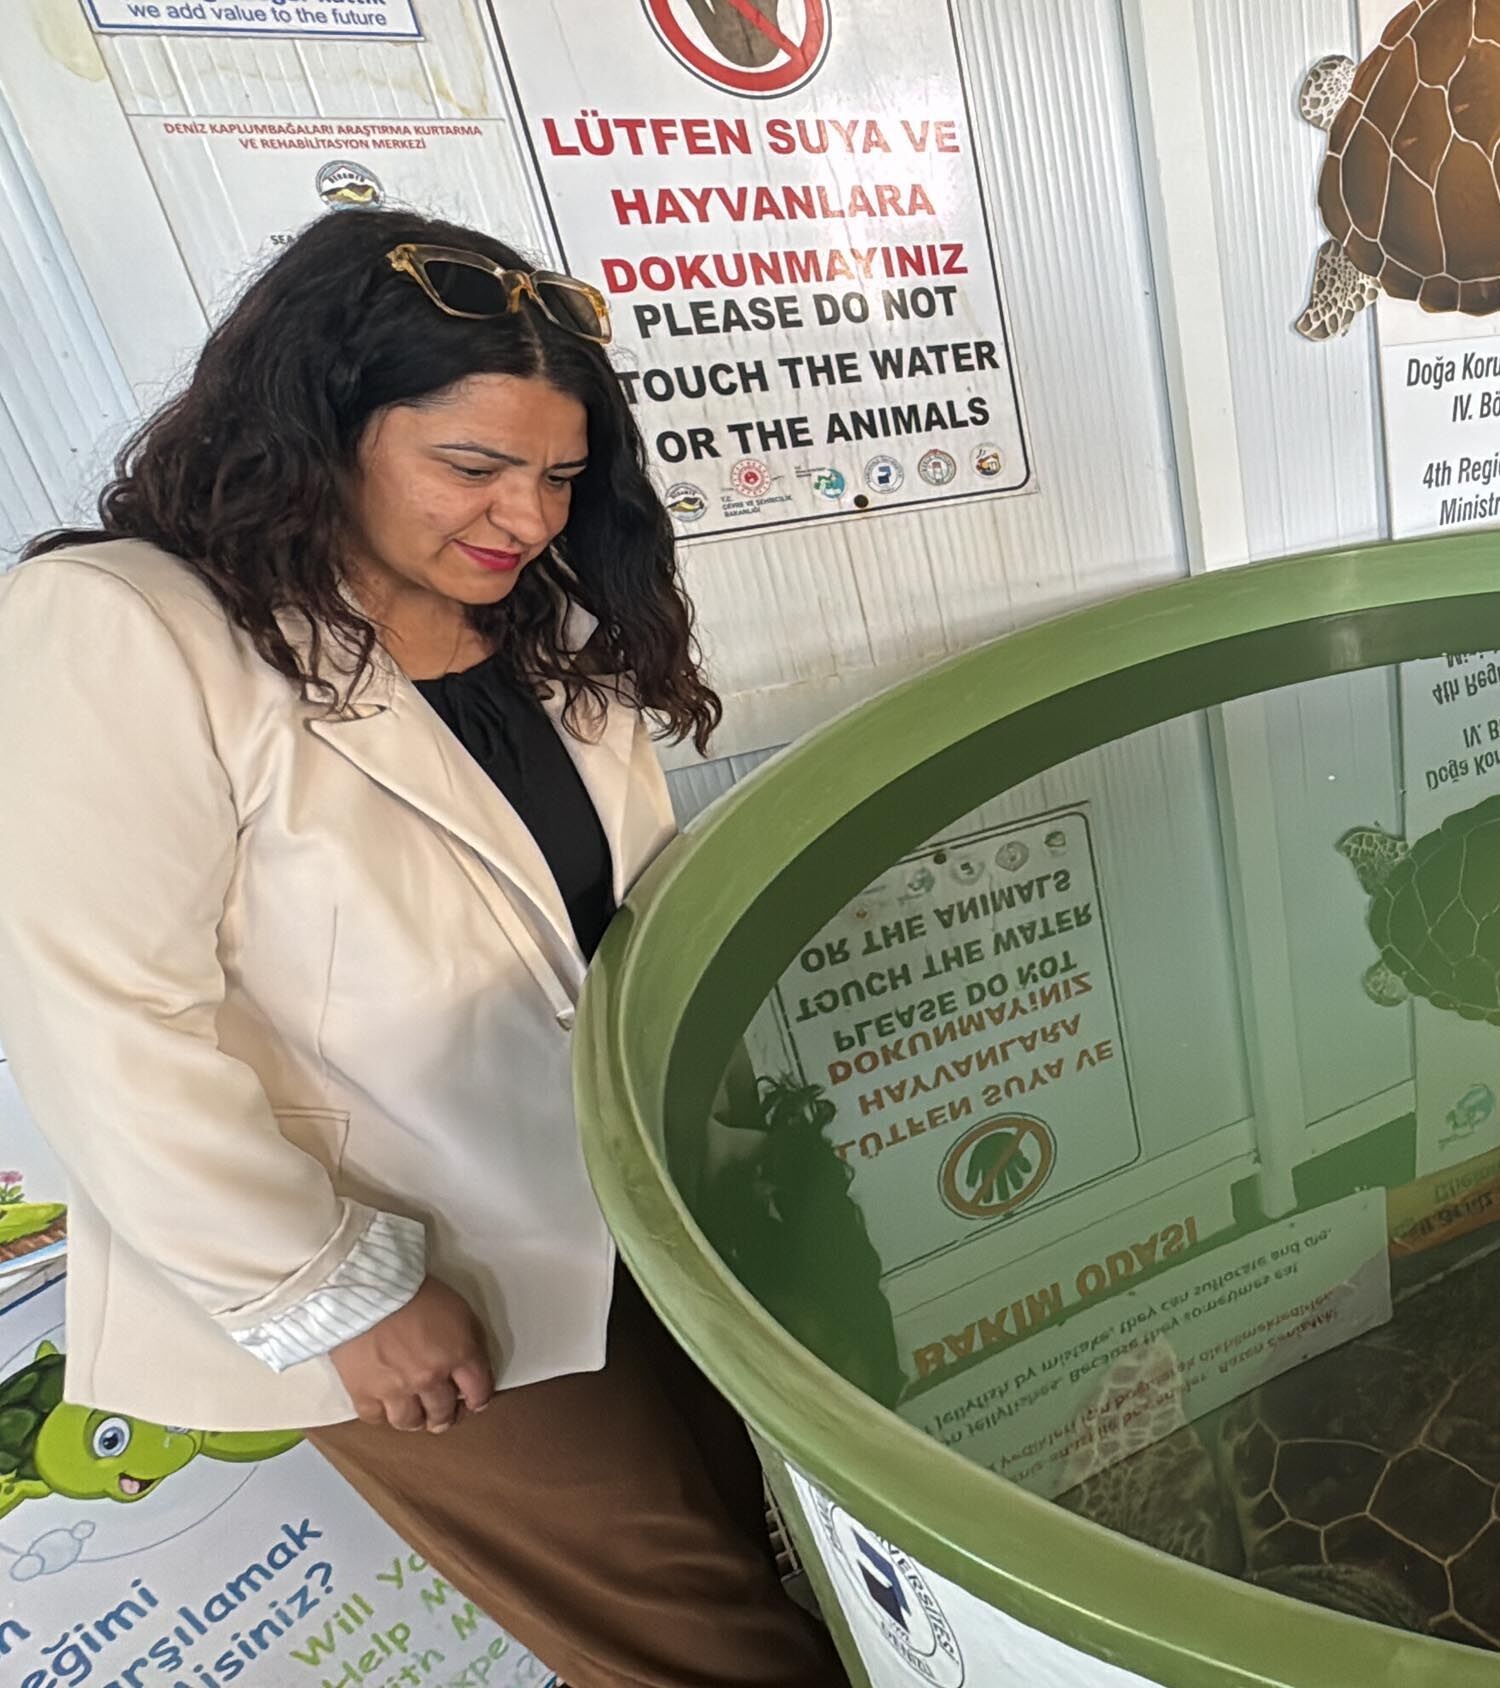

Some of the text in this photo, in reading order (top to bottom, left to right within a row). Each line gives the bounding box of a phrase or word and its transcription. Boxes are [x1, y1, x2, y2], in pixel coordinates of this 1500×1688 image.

[129, 4, 386, 26] we add value to the future
[240, 138, 257, 148] VE
[414, 125, 482, 136] KURTARMA
[542, 110, 960, 156] LÜTFEN SUYA VE
[611, 183, 937, 225] HAYVANLARA
[601, 243, 968, 294] DOKUNMAYINIZ
[633, 285, 958, 339] PLEASE DO NOT
[616, 340, 1000, 405] TOUCH THE WATER
[1406, 356, 1455, 390] Doğa
[1452, 394, 1472, 422] IV.
[655, 396, 990, 464] OR THE ANIMALS
[1422, 461, 1451, 490] 4th
[290, 1592, 375, 1666] Will
